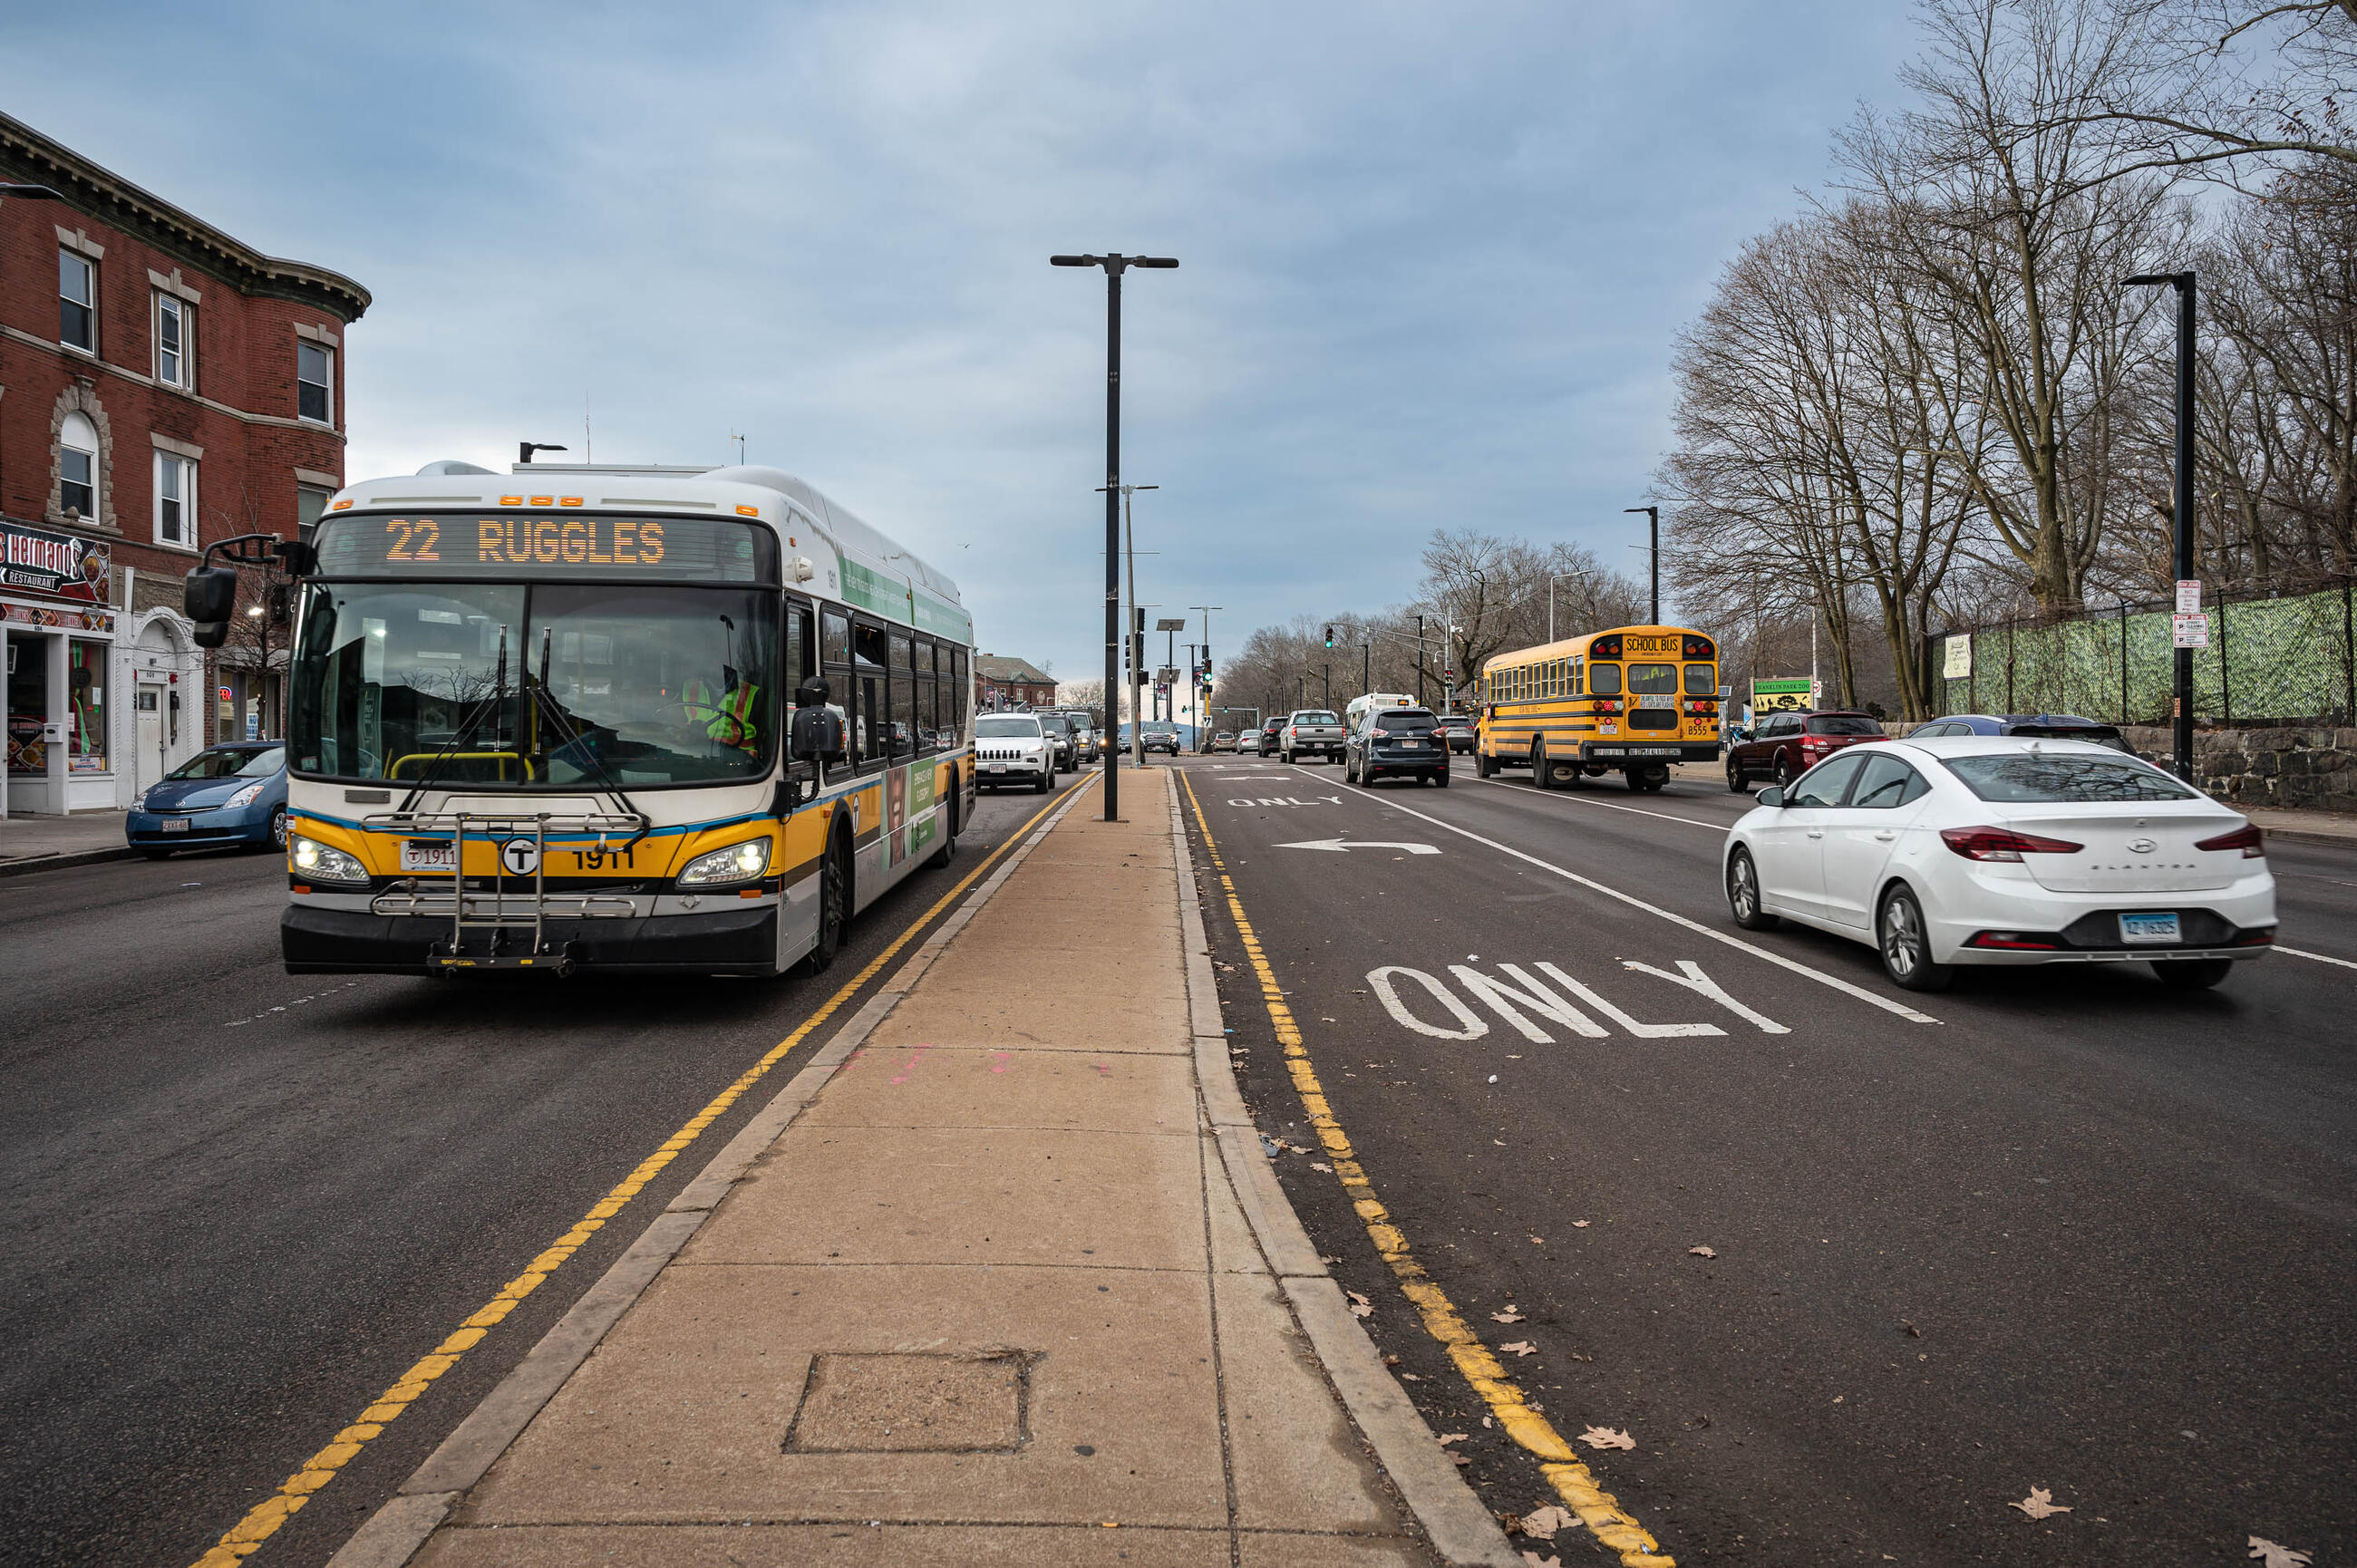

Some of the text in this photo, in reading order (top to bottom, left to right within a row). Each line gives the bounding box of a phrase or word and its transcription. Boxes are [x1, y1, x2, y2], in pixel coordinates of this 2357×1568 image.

[386, 519, 664, 563] 22 RUGGLES
[9, 570, 56, 589] RESTAURANT
[1626, 638, 1678, 652] SCHOOL BUS
[1688, 726, 1707, 735] B555
[1227, 797, 1343, 807] ONLY
[423, 849, 456, 865] 1911
[509, 848, 533, 869] T
[572, 847, 635, 870] 1911
[1365, 960, 1793, 1044] ONLY
